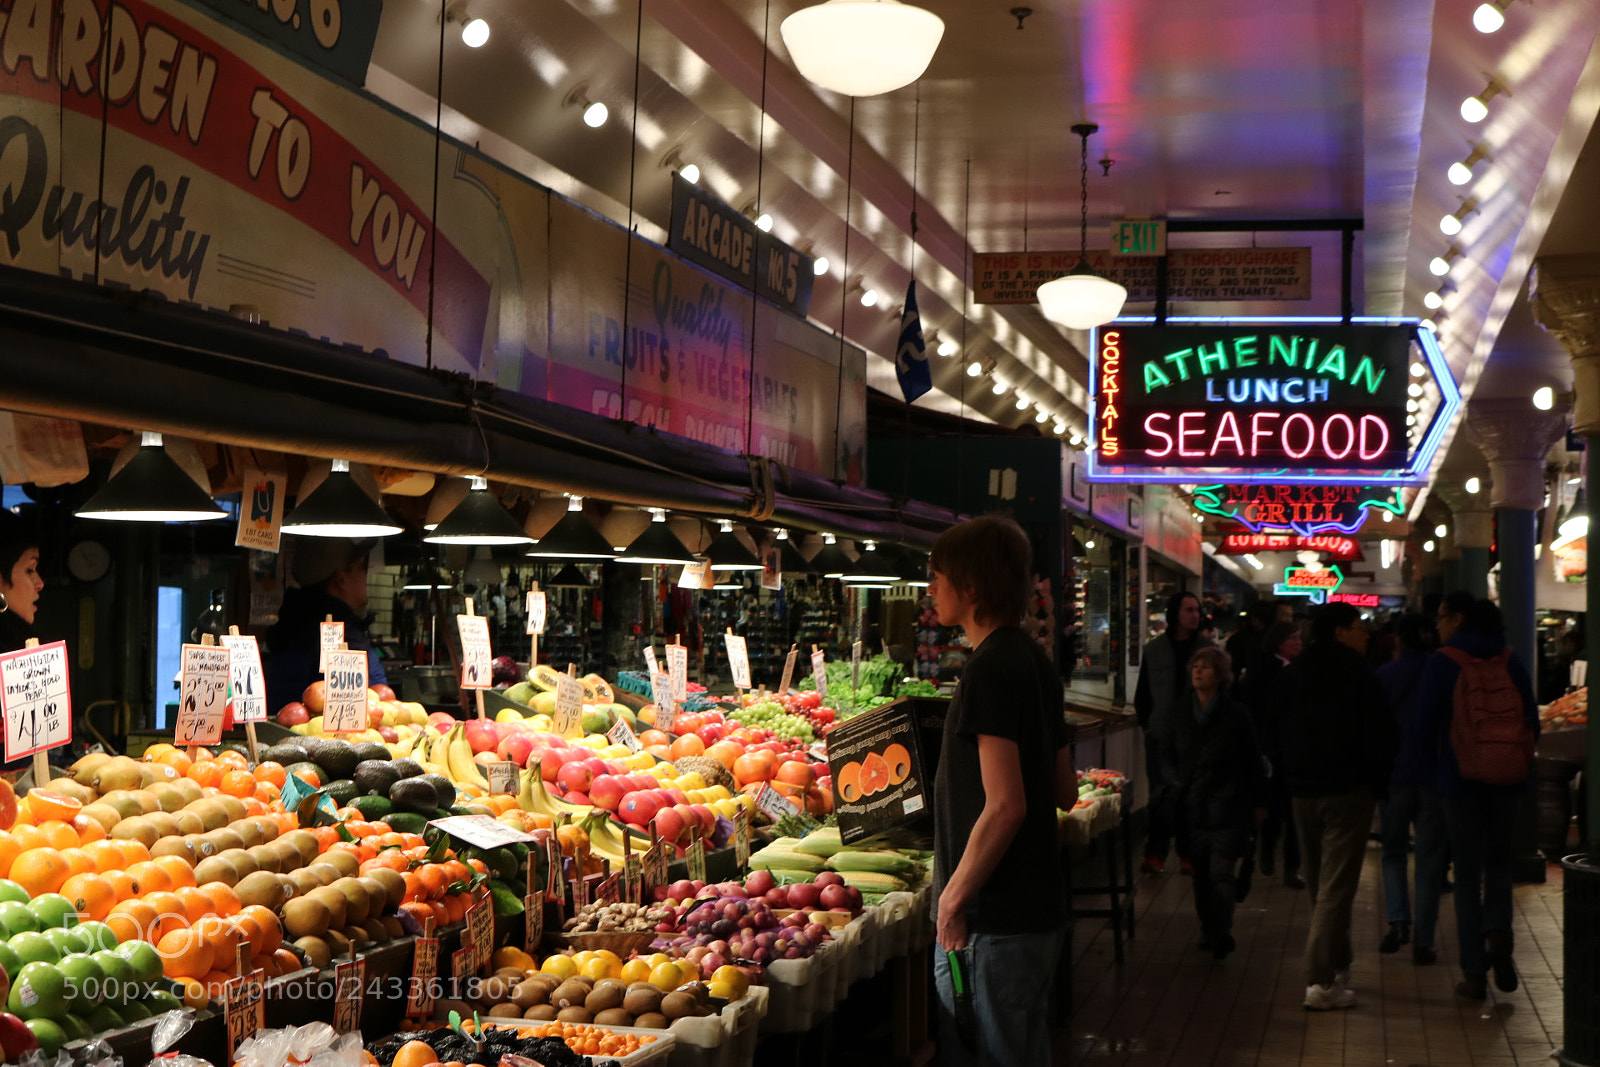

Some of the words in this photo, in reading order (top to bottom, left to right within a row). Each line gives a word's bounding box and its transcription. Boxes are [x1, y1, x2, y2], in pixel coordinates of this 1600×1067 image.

[0, 0, 219, 147] ARDEN
[247, 86, 313, 202] TO
[349, 161, 427, 293] YOU
[0, 115, 212, 301] Quality
[681, 197, 754, 276] ARCADE
[1120, 222, 1158, 253] EXIT
[983, 256, 1018, 269] THIS
[1028, 256, 1042, 269] IS
[1092, 255, 1106, 268] A
[1113, 256, 1176, 267] PUBLC
[1182, 252, 1300, 267] THOROUGHFARE
[984, 271, 992, 279] IT
[999, 270, 1009, 280] IS
[1016, 270, 1024, 279] A
[1123, 268, 1186, 278] RESEVED
[1192, 268, 1214, 277] FOR
[1219, 267, 1238, 276] THE
[1242, 266, 1296, 276] PATRONS
[981, 281, 995, 290] OF
[999, 280, 1017, 289] THE
[652, 258, 733, 364] Quality
[588, 310, 671, 384] FRUITS
[1142, 334, 1388, 395] ATHENIAN
[1101, 331, 1121, 457] COCKTAILS
[1205, 377, 1330, 404] LUNCH
[1142, 410, 1391, 462] SEAFOOD
[1225, 484, 1361, 504] MARKET
[1243, 502, 1344, 524] GRILL
[1286, 576, 1339, 587] GROCERY
[330, 670, 364, 690] SUMO
